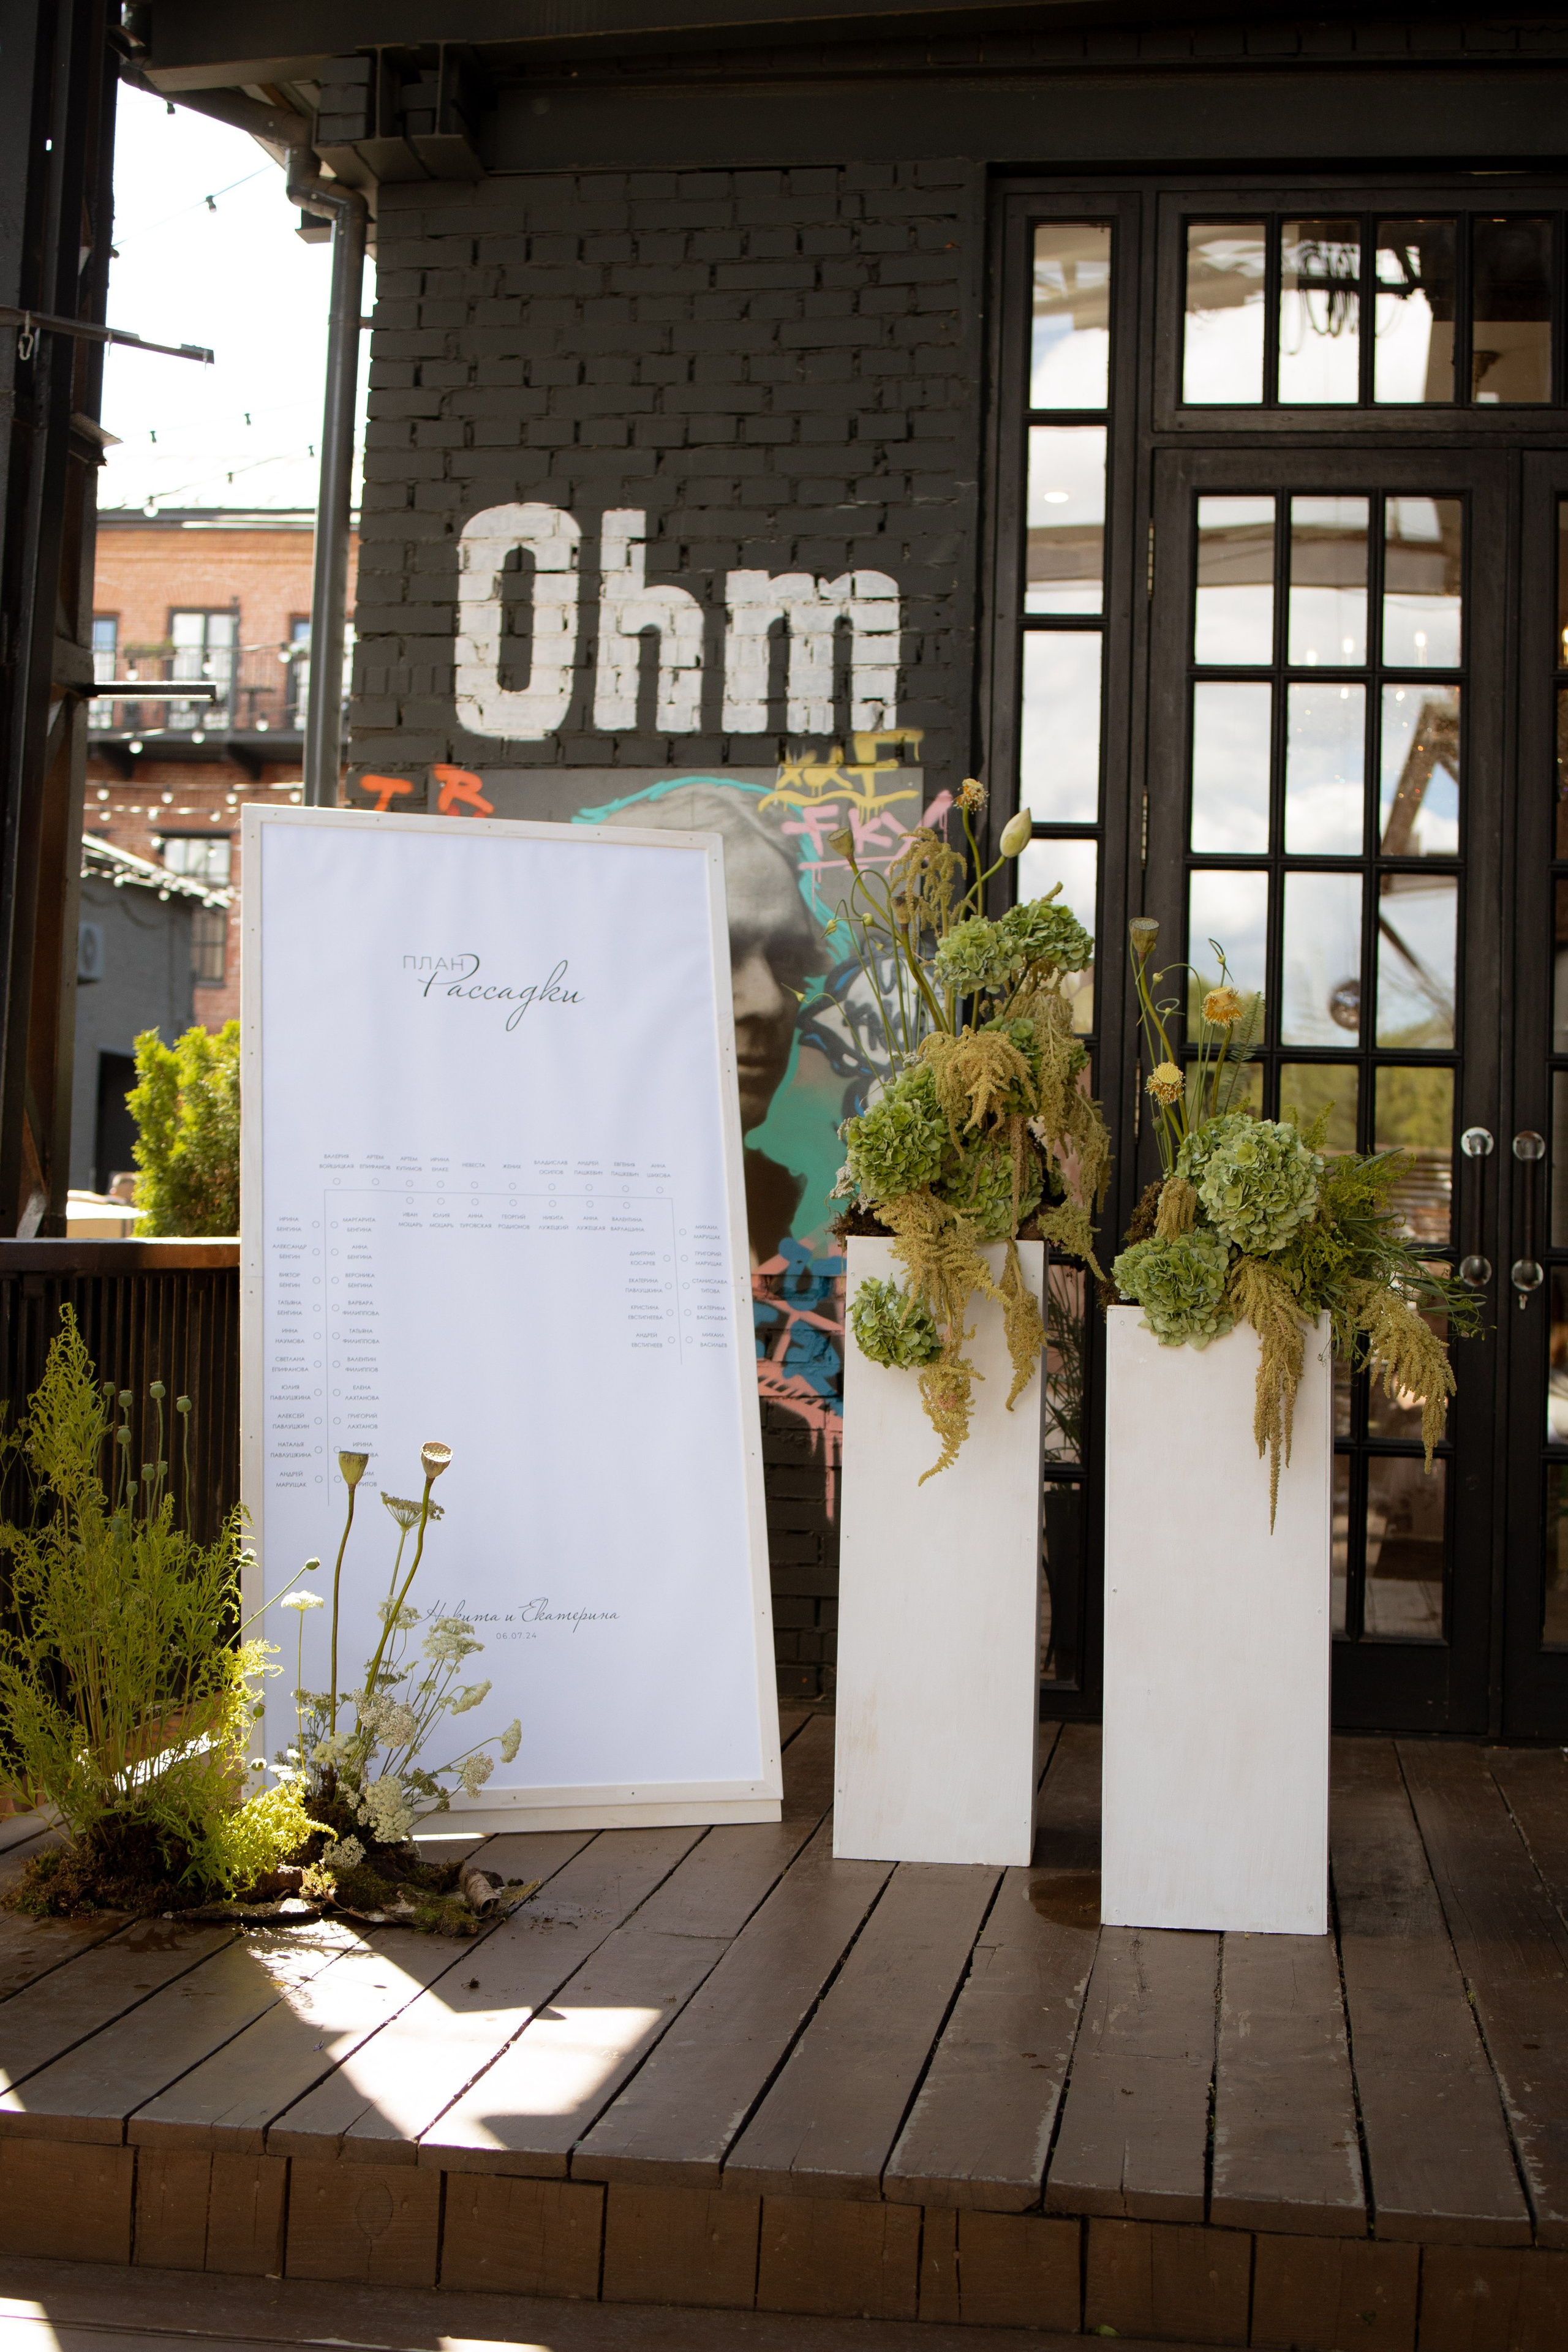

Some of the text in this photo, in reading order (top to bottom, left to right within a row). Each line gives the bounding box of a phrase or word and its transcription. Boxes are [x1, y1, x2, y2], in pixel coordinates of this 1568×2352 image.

[454, 502, 900, 741] Ohm
[403, 955, 464, 971] ПЛАН
[417, 953, 586, 1031] Рассадки
[417, 1599, 501, 1623] Нкита
[518, 1597, 620, 1634] Екатерина
